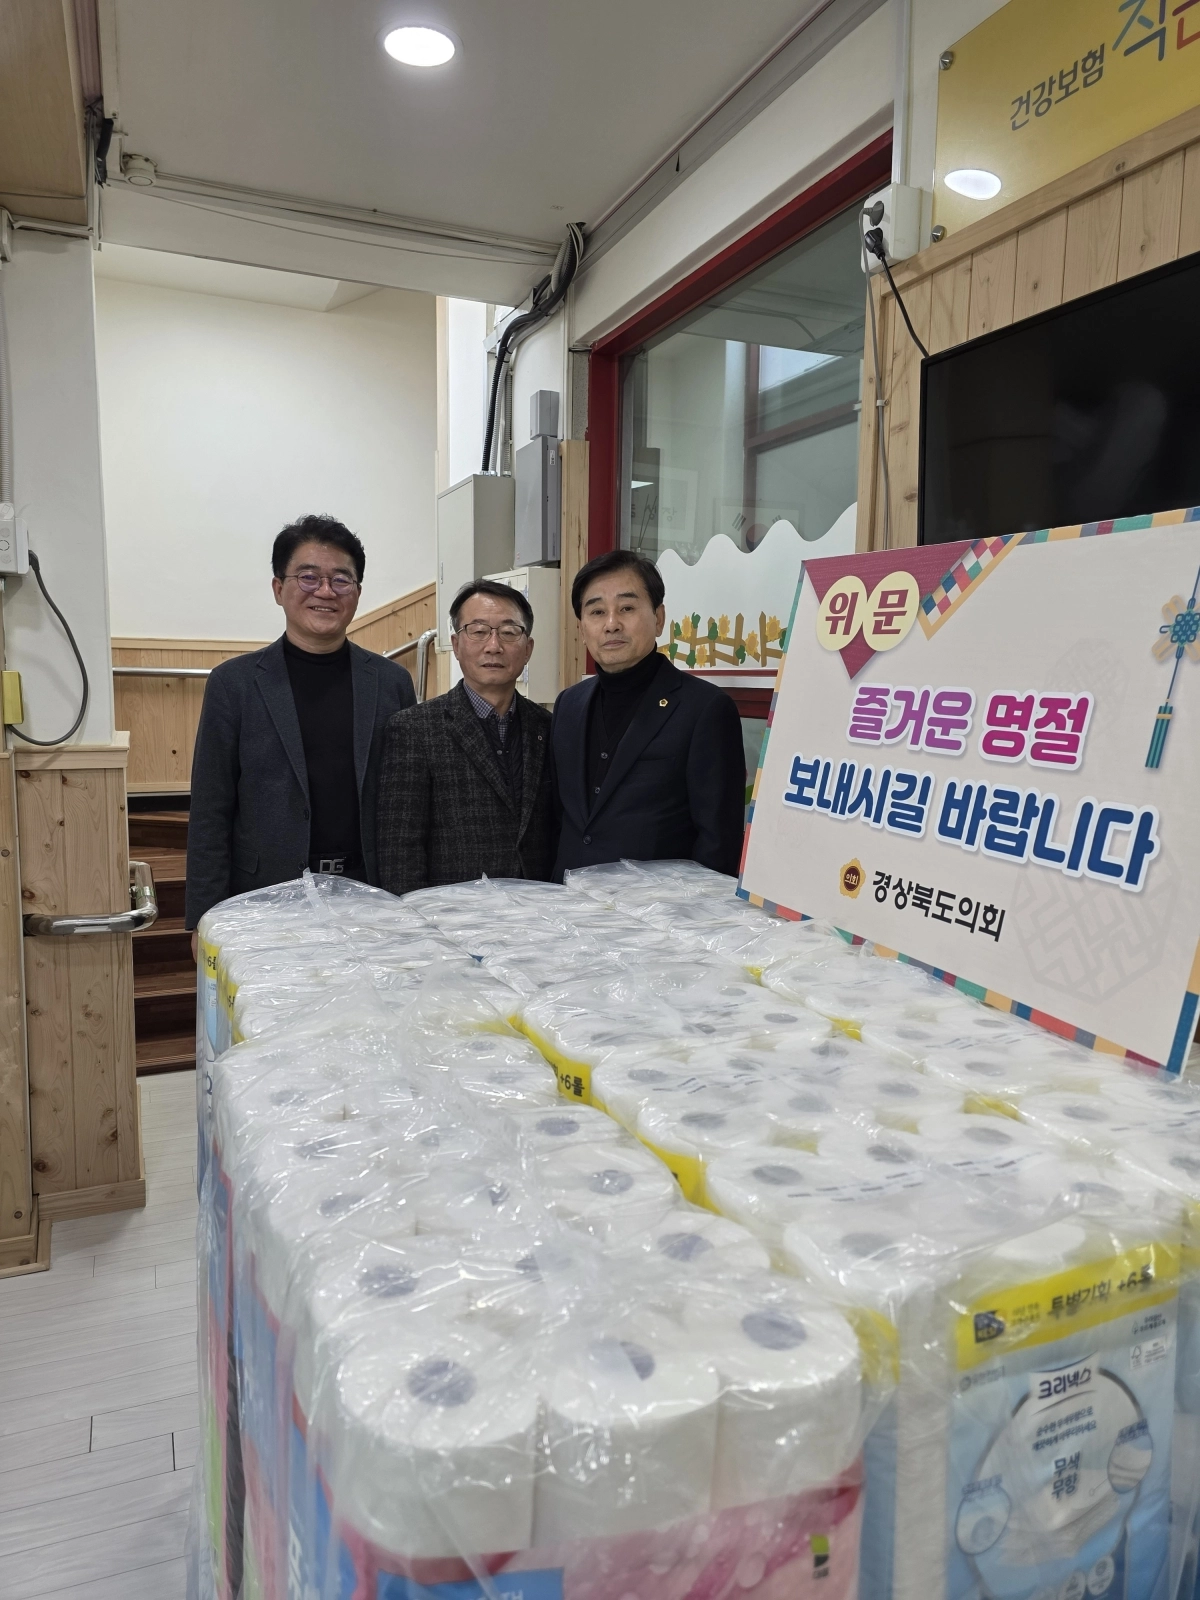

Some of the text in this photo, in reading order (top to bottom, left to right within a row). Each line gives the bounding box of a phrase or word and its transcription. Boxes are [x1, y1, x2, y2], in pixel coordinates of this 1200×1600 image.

[1010, 42, 1106, 132] 건강보험
[825, 588, 909, 636] 위문
[847, 685, 1091, 766] 즐거운 명절
[782, 754, 1156, 886] 보내시길 바랍니다
[844, 873, 859, 886] 의회
[871, 869, 1007, 943] 경상북도의회
[560, 1073, 585, 1098] +6롤
[1037, 1367, 1093, 1401] 크리넥스
[1053, 1450, 1081, 1478] 무색
[1051, 1473, 1079, 1500] 무향
